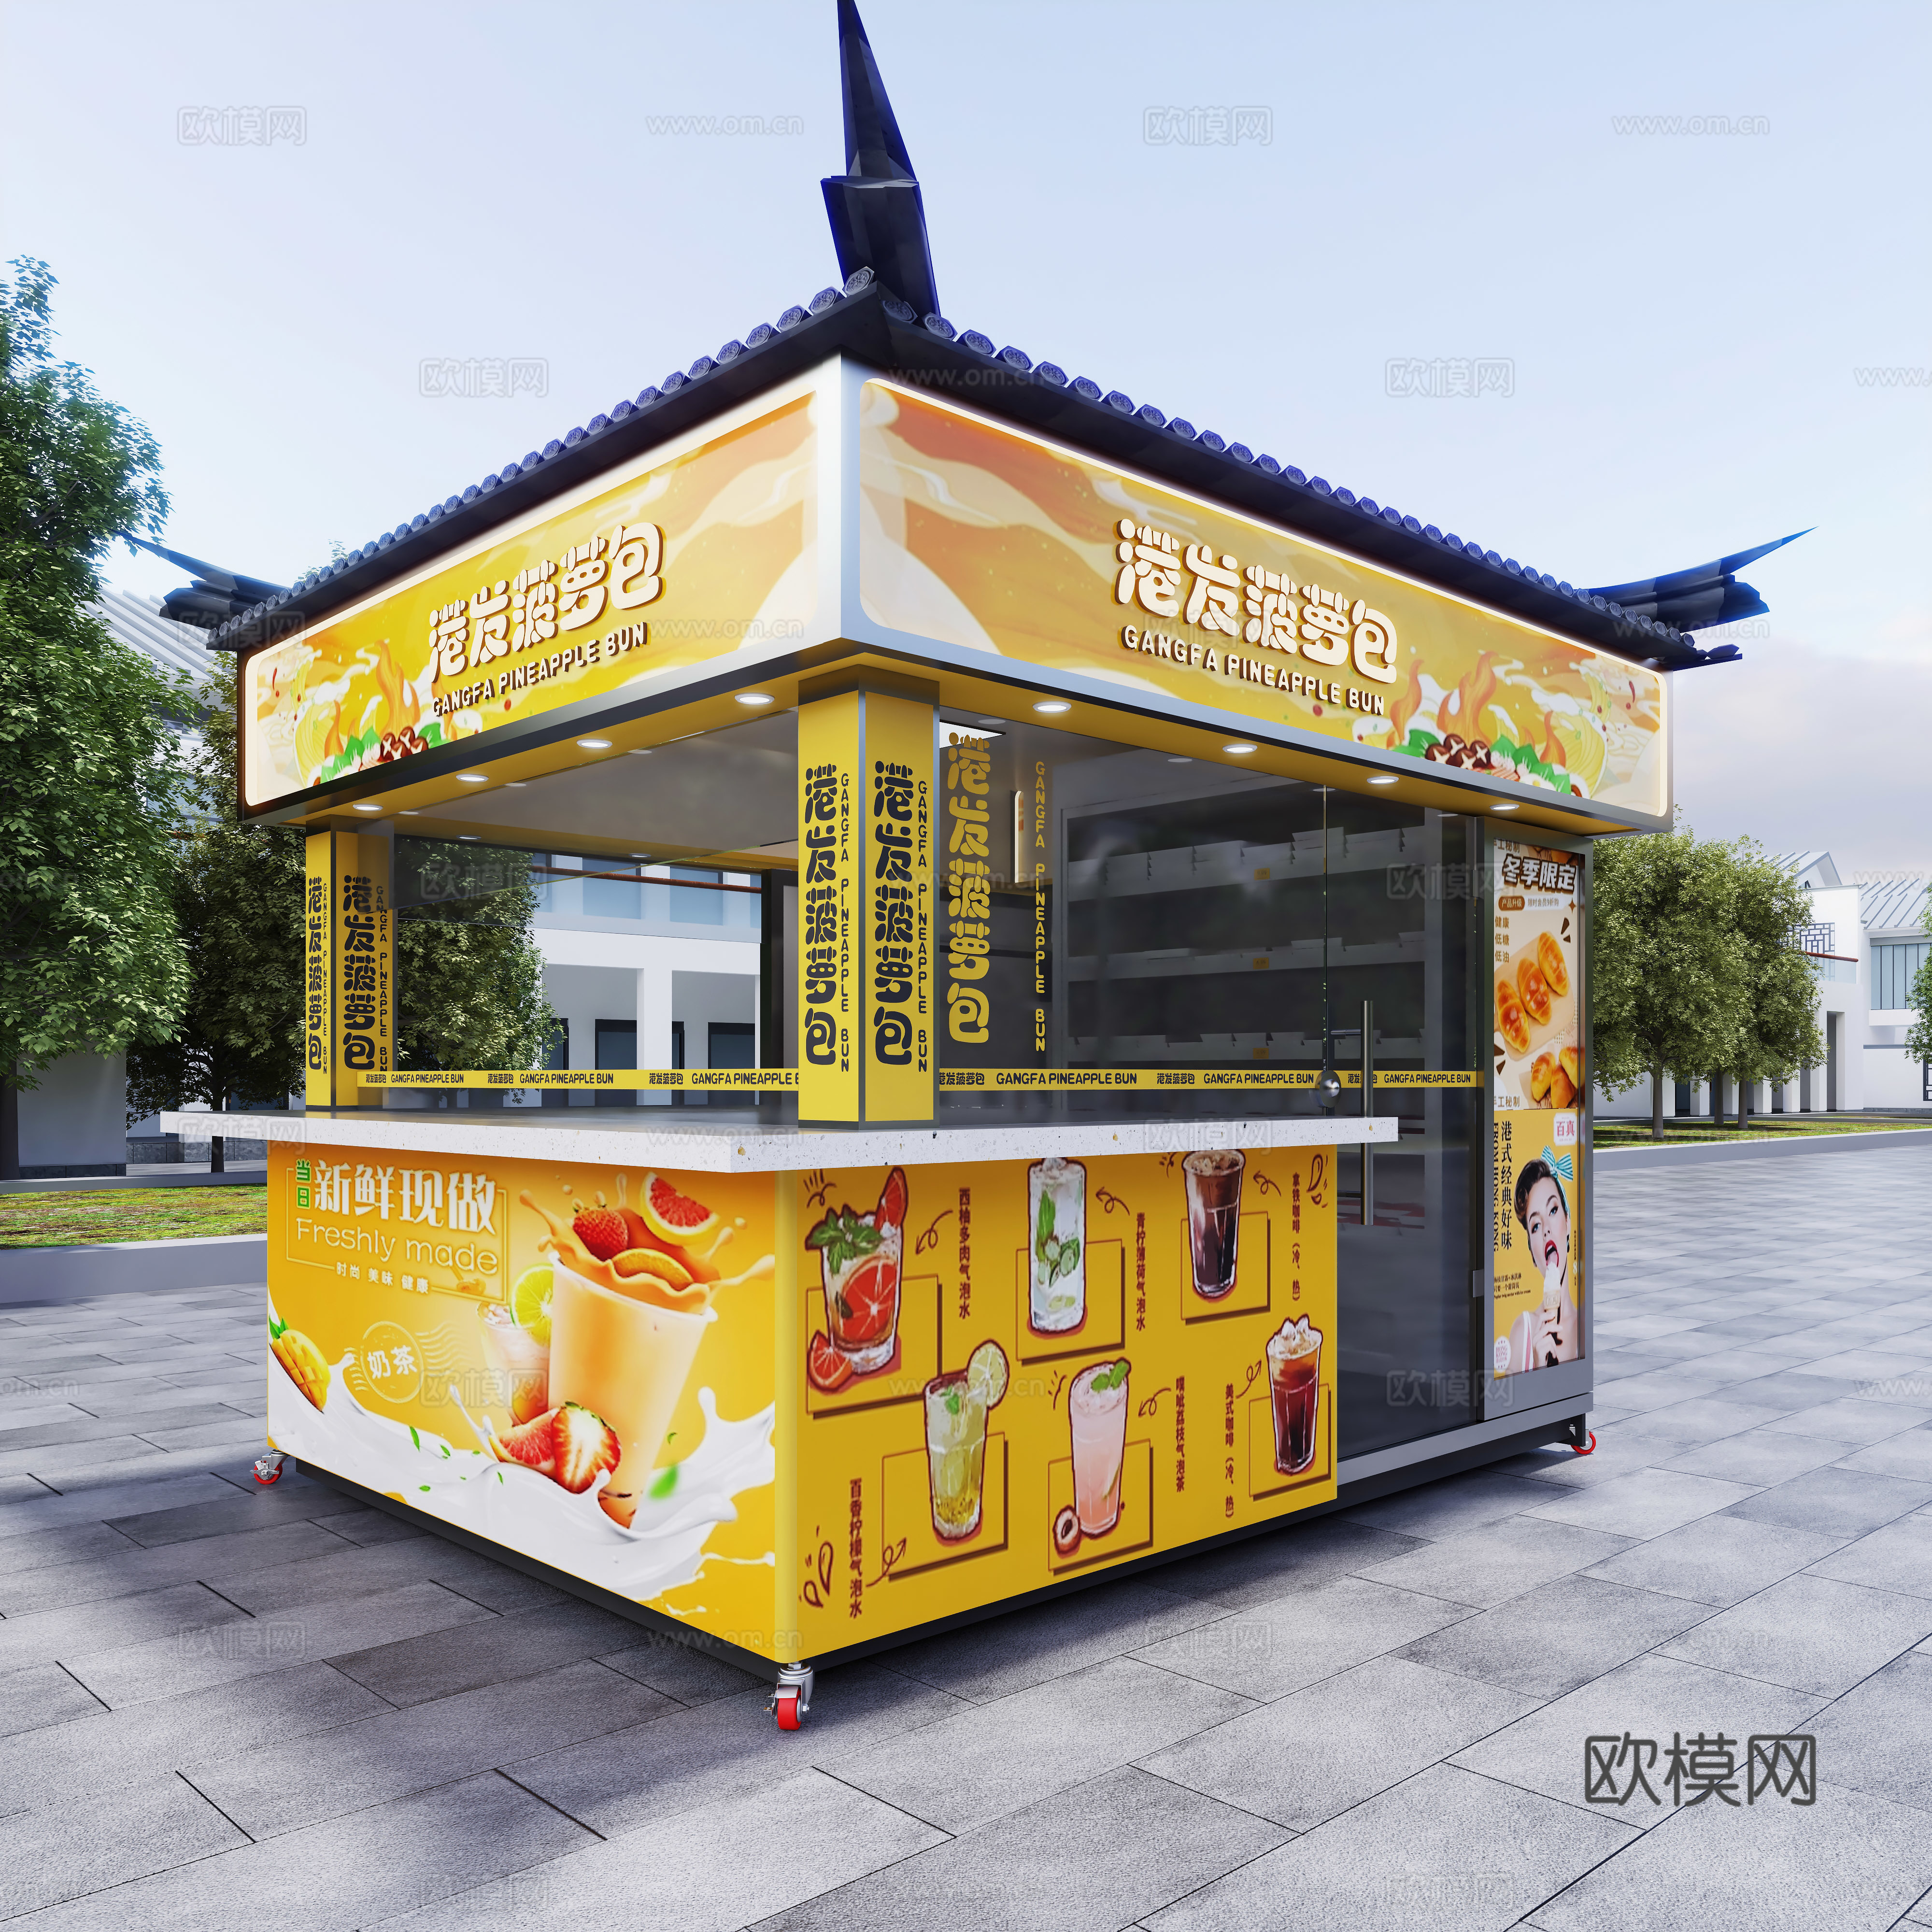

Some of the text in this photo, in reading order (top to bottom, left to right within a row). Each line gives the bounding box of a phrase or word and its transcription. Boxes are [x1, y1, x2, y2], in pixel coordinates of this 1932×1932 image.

[428, 522, 665, 682] 港发菠萝包
[1114, 518, 1397, 684] 港发菠萝包
[432, 622, 648, 717] GANGFA PINEAPPLE BUN
[1121, 625, 1385, 716] GANGFA PINEAPPLE BUN
[947, 732, 991, 1044] 港发菠萝包
[1502, 853, 1576, 893] 冬季限定
[805, 764, 838, 1065] 港发菠萝包
[841, 773, 849, 1072] GANGFA PINEAPPLE BUN
[874, 761, 913, 1065] 港发菠萝包
[918, 781, 927, 1072] GANGFA PINEAPPLE BUN
[1035, 761, 1046, 1052] GANGFA PINEAPPLE BUN
[1495, 916, 1509, 928] 健康
[1502, 898, 1522, 908] 产品升级
[309, 876, 322, 1070] 港发菠萝包
[343, 875, 376, 1070] 港发菠萝包
[1495, 950, 1509, 963] 低油
[366, 1074, 386, 1083] 港发菠萝包
[391, 1074, 464, 1083] GANGFA PINEAPPLE BUN
[488, 1073, 513, 1084] 港发菠萝包
[520, 1073, 613, 1084] GANGFA PINEAPPLE BUN
[649, 1072, 683, 1085] 港发菠萝包
[692, 1073, 731, 1084] GANGFA
[734, 1073, 793, 1084] PINEAPPLE
[996, 1073, 1136, 1084] GANGFA PINEAPPLE BUN
[1157, 1073, 1195, 1084] 港发菠萝包
[1204, 1073, 1314, 1084] GANGFA PINEAPPLE BUN
[1384, 1074, 1471, 1083] GANGFA PINEAPPLE BUN
[295, 1159, 311, 1209] 当日
[314, 1159, 497, 1236] 新鲜现做
[1501, 1121, 1512, 1250] 港式经典好味
[296, 1218, 498, 1275] Freshly made
[959, 1187, 970, 1319] 西柚多肉气泡水
[336, 1262, 429, 1294] 时尚 美味 健康
[367, 1345, 418, 1379] 奶茶
